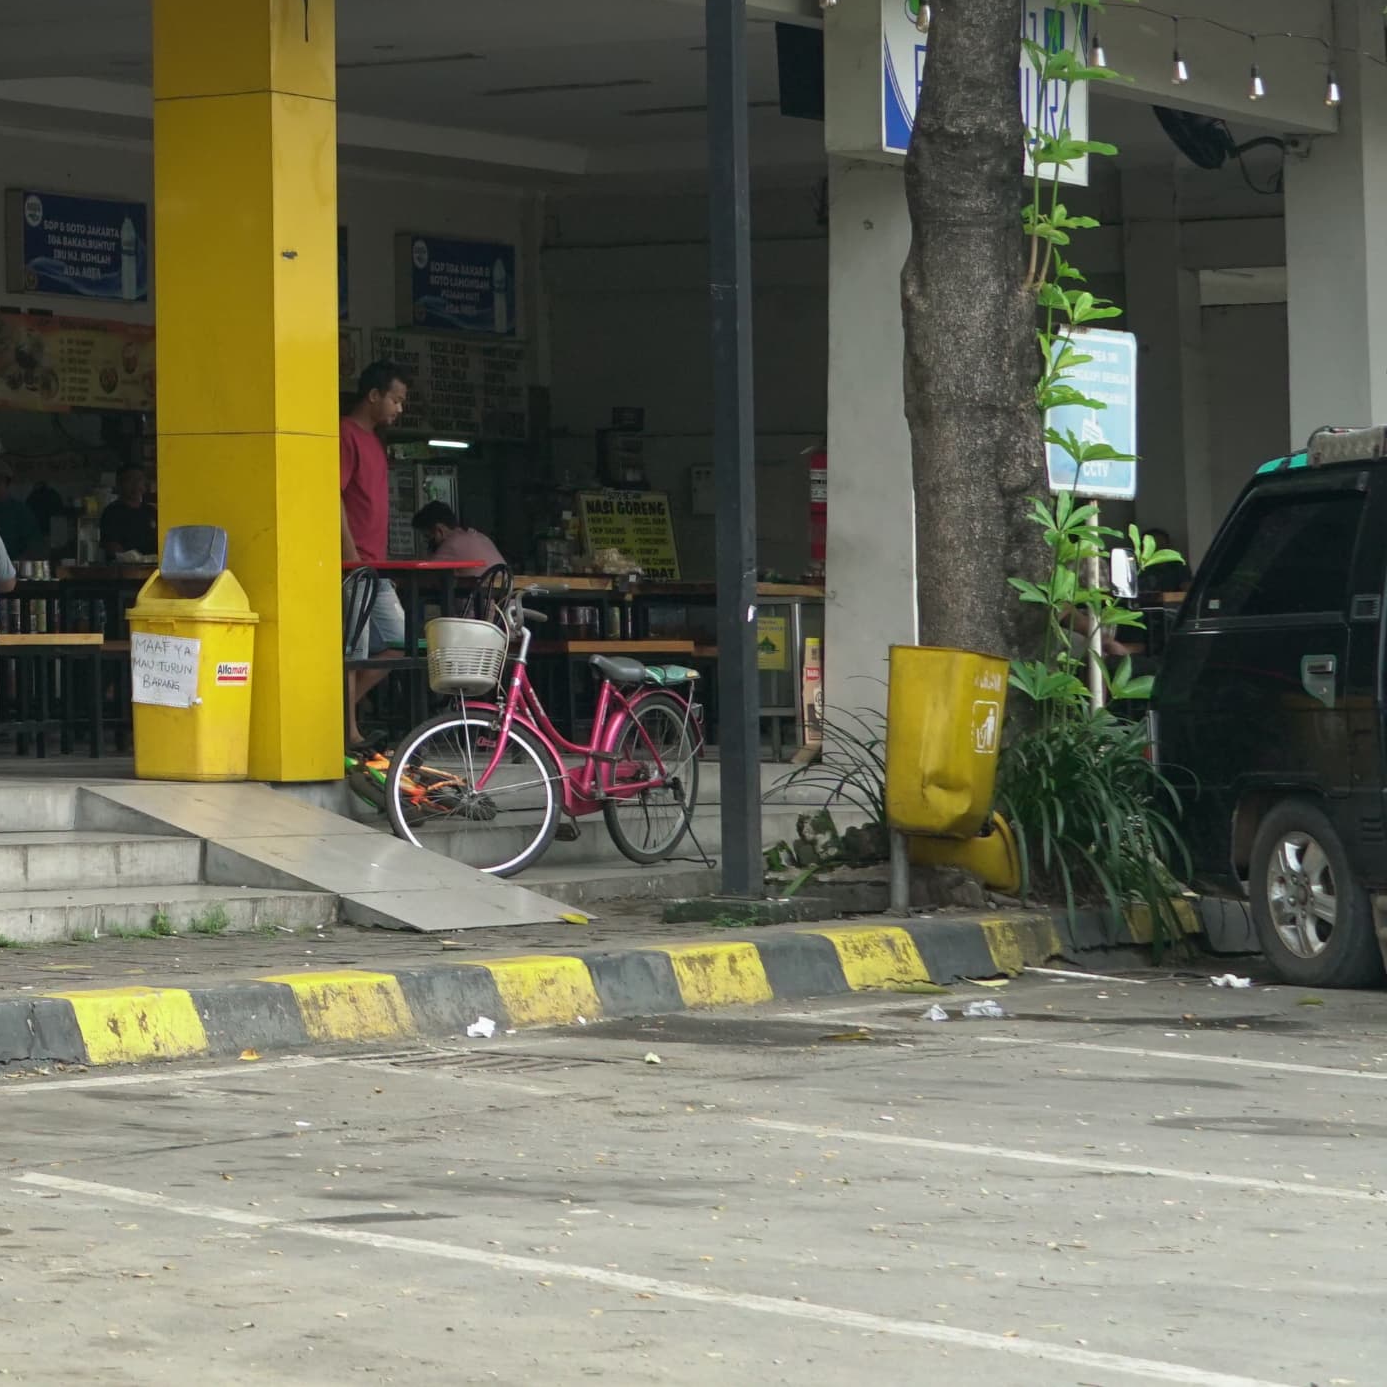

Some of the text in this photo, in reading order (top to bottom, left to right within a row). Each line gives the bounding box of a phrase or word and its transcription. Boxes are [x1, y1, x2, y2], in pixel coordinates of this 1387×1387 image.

[1083, 461, 1109, 478] CCTV
[586, 499, 666, 516] NASI GORENG
[135, 638, 192, 656] MAAF YA
[132, 657, 193, 675] MAU TURUN
[217, 664, 249, 676] Alfamart
[142, 675, 180, 691] BARANG
